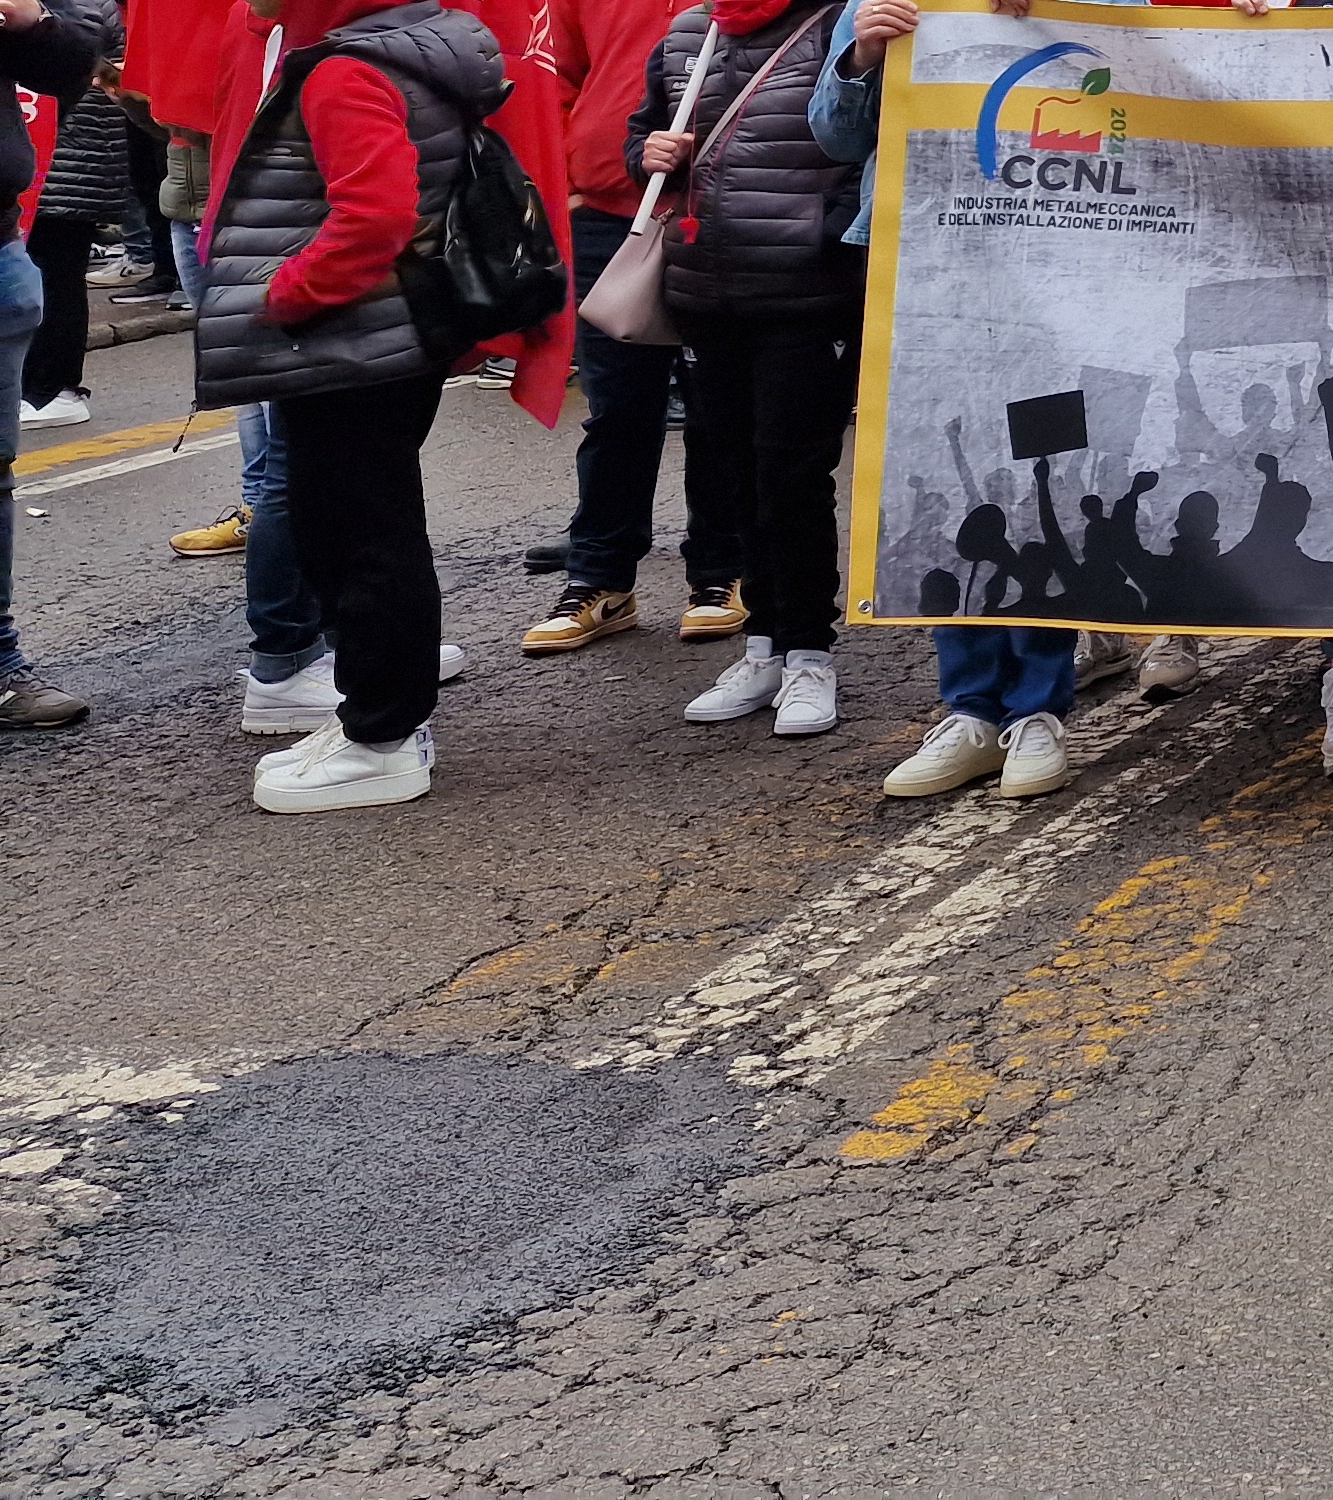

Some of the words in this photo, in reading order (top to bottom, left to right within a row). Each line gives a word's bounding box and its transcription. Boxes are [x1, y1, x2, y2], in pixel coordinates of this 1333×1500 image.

[1110, 107, 1127, 154] 2024
[1001, 154, 1137, 196] CCNL
[937, 212, 945, 226] E
[949, 212, 1101, 231] DELL'INSTALLAZIONE
[1107, 218, 1123, 231] DI
[1126, 219, 1196, 236] IMPIANTI
[953, 197, 1028, 211] INDUSTRIA
[1032, 198, 1177, 219] METALMECCANICA
